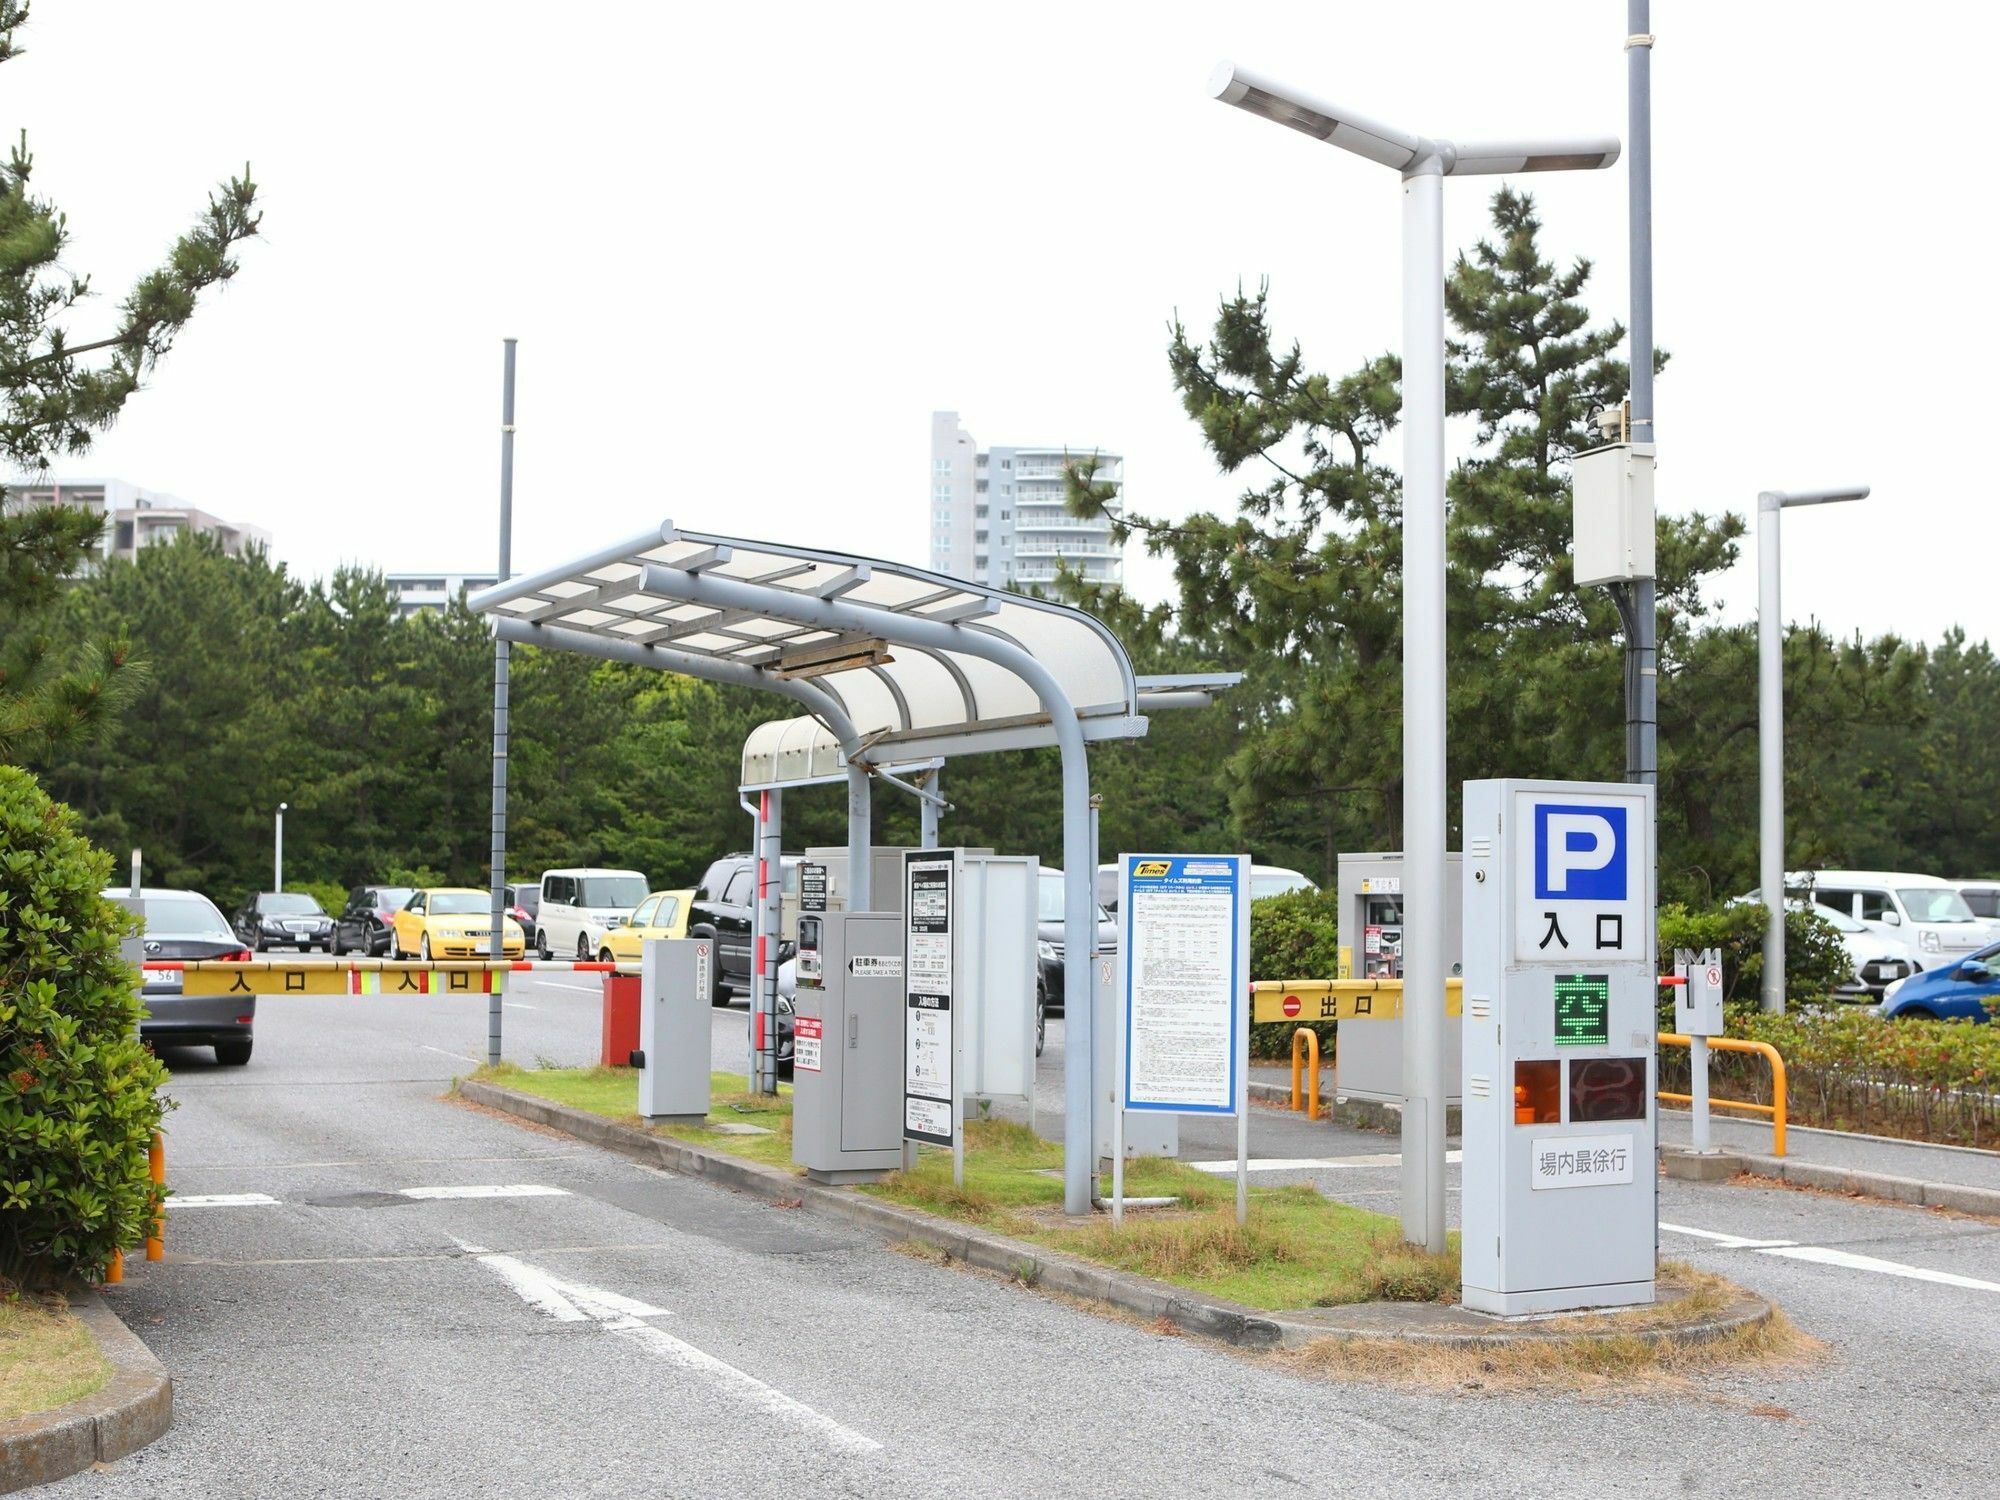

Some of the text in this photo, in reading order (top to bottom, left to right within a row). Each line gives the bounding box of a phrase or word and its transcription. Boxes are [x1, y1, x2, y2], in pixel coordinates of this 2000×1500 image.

[1547, 813, 1616, 891] P
[1140, 864, 1168, 875] Times
[1539, 912, 1622, 949] 入口
[230, 971, 305, 992] 入口
[398, 970, 469, 991] 入口
[1320, 995, 1372, 1018] 出口
[1554, 974, 1609, 1045] 空
[1539, 1148, 1626, 1176] 場内最徐行
